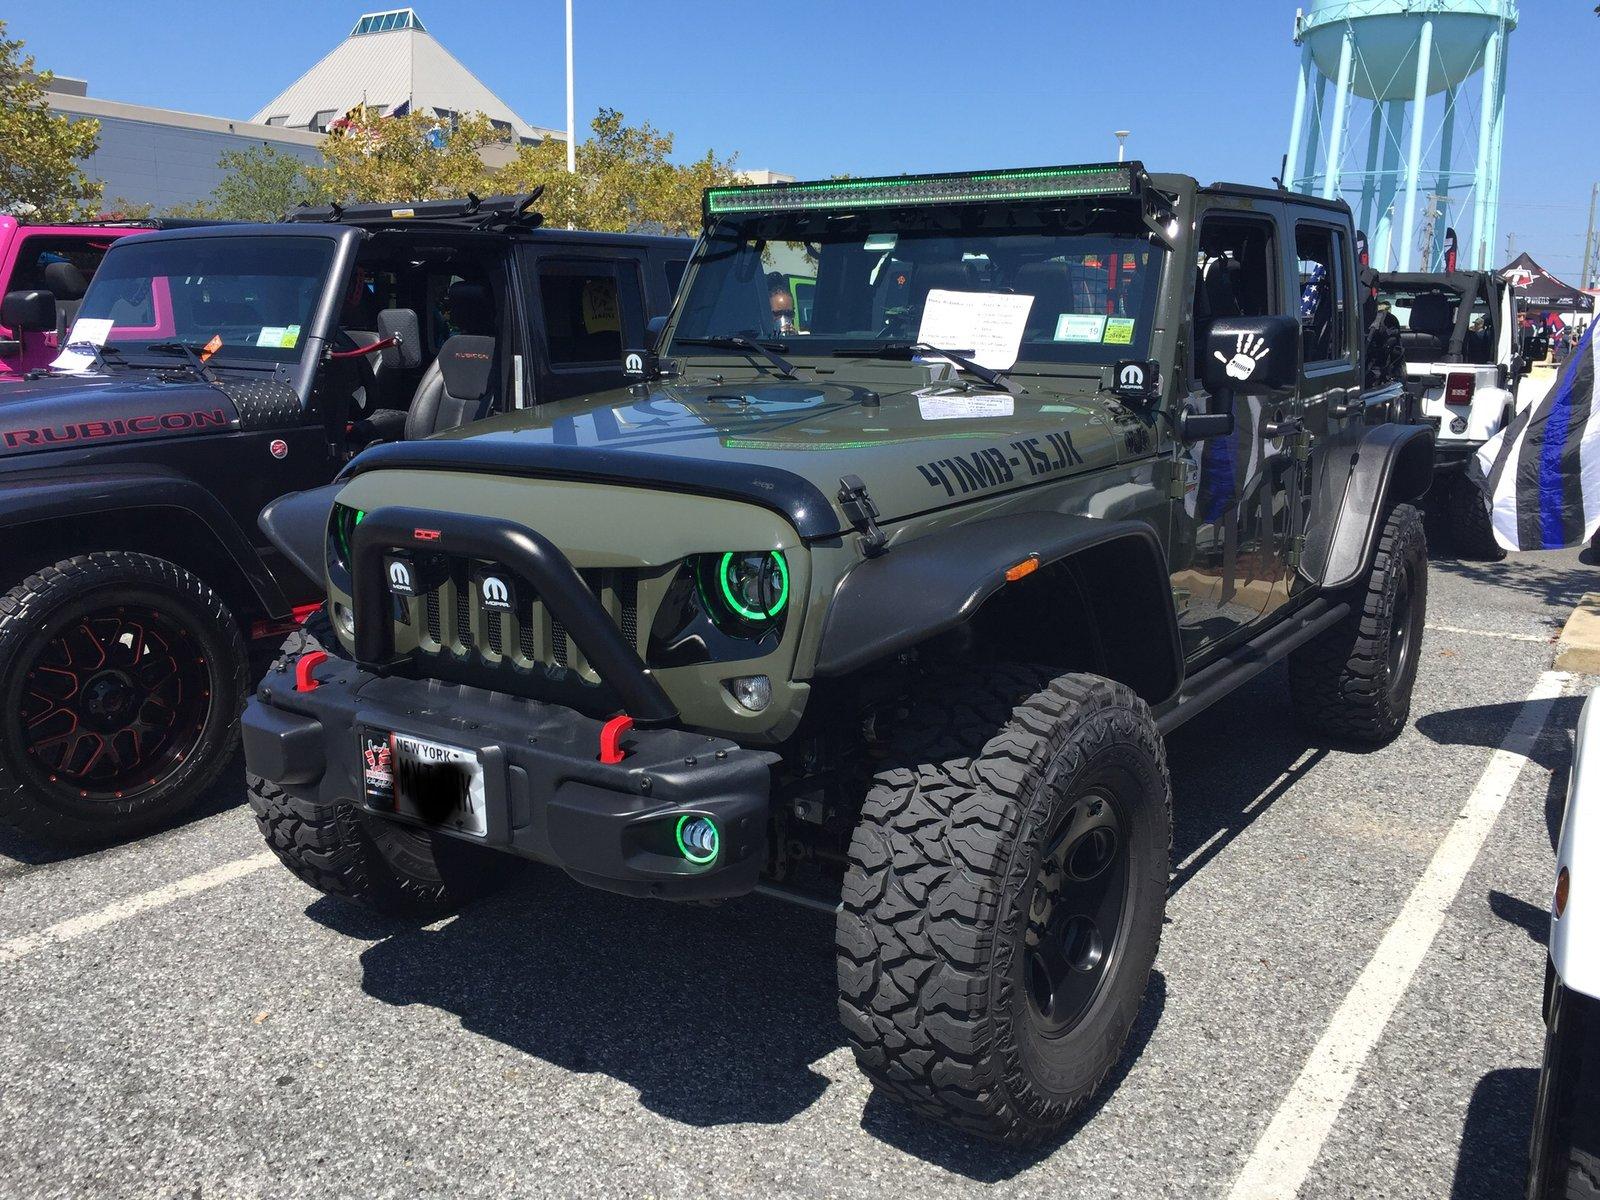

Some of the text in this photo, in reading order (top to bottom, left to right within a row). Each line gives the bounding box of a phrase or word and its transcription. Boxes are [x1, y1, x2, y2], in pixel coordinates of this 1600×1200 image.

[3, 409, 228, 448] RUBICON
[485, 600, 511, 608] MOPAR
[396, 739, 451, 762] NEW YORK
